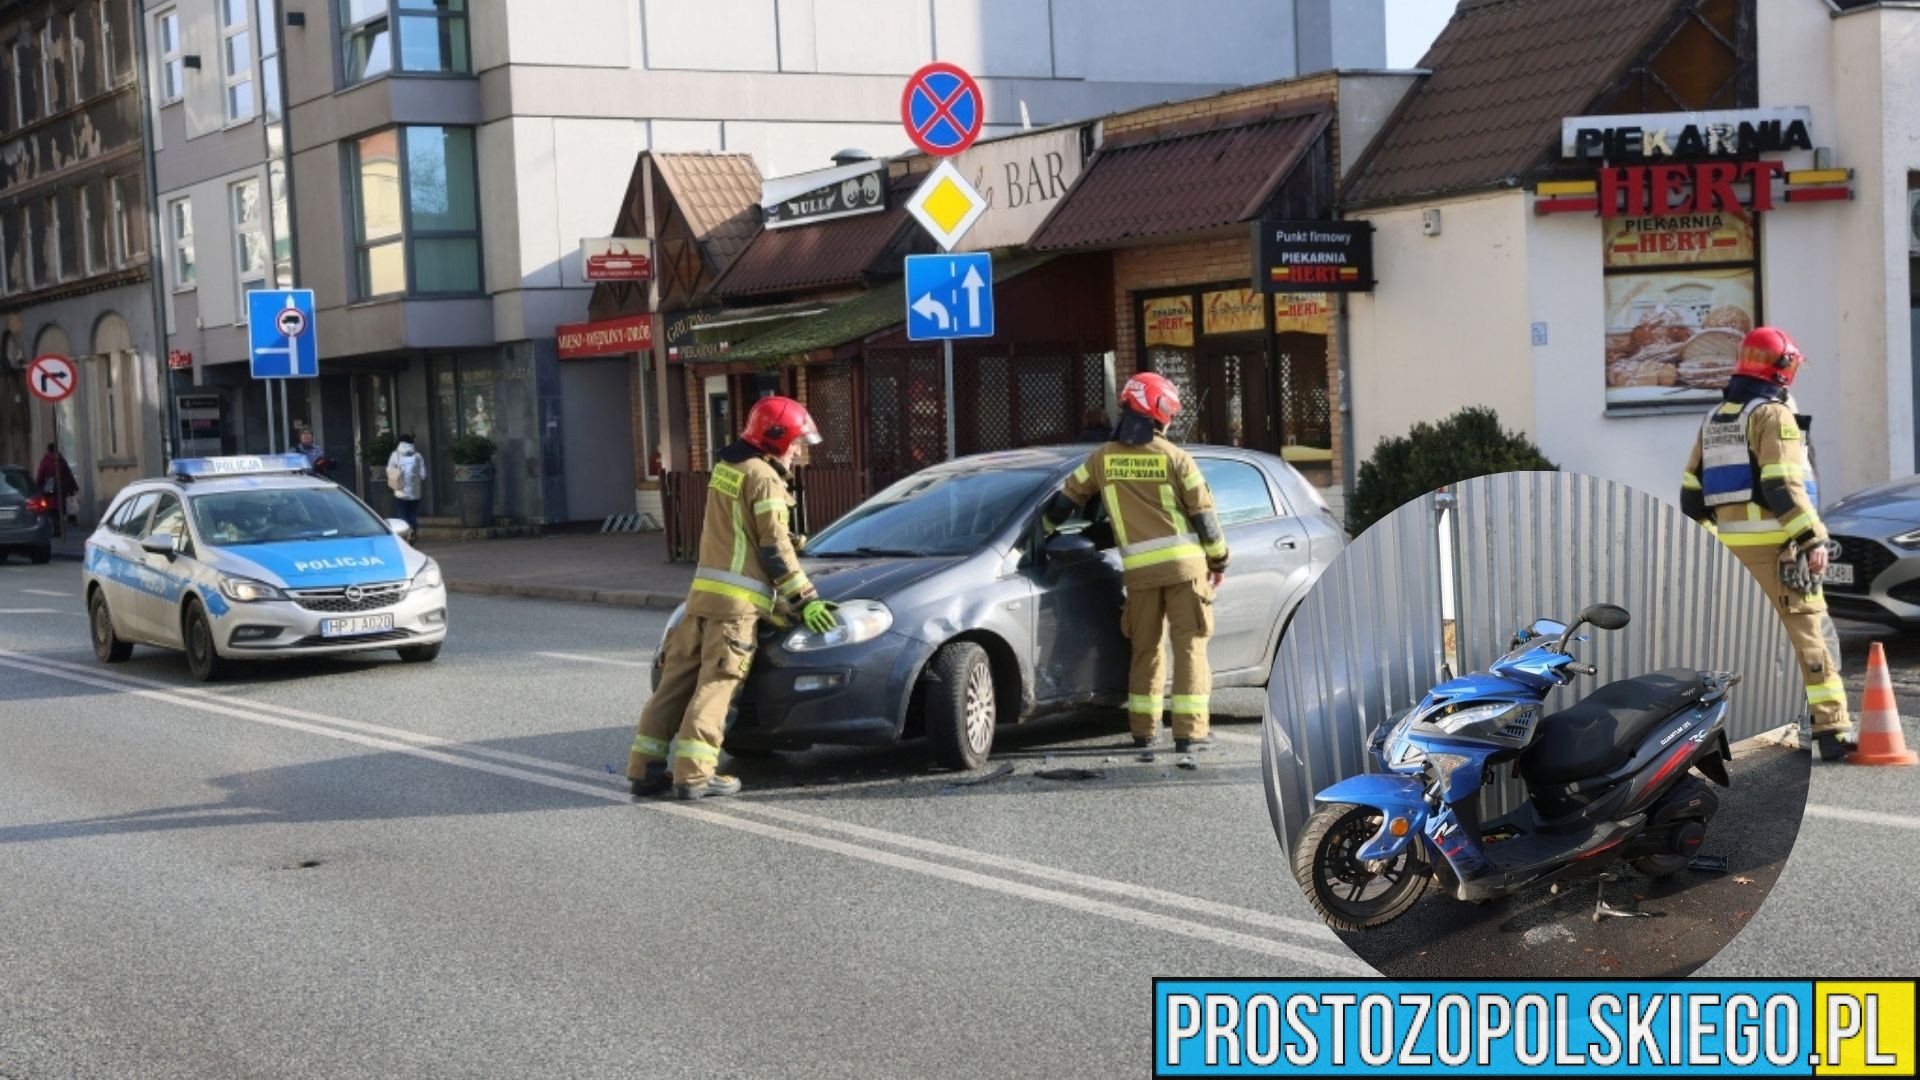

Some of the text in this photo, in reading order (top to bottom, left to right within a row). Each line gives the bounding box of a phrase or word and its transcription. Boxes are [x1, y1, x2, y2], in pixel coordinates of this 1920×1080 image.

[1576, 119, 1813, 158] PIEKARNIA
[1004, 151, 1069, 208] BAR
[1594, 160, 1785, 218] HERT
[1625, 215, 1723, 232] PIEKARNIA
[1276, 230, 1352, 245] Punkt firmowy
[1638, 230, 1711, 253] HERT
[1282, 251, 1347, 264] PIEKARNIA
[1288, 266, 1340, 283] HERT
[1288, 301, 1319, 317] HERT
[294, 556, 385, 573] POLICJA
